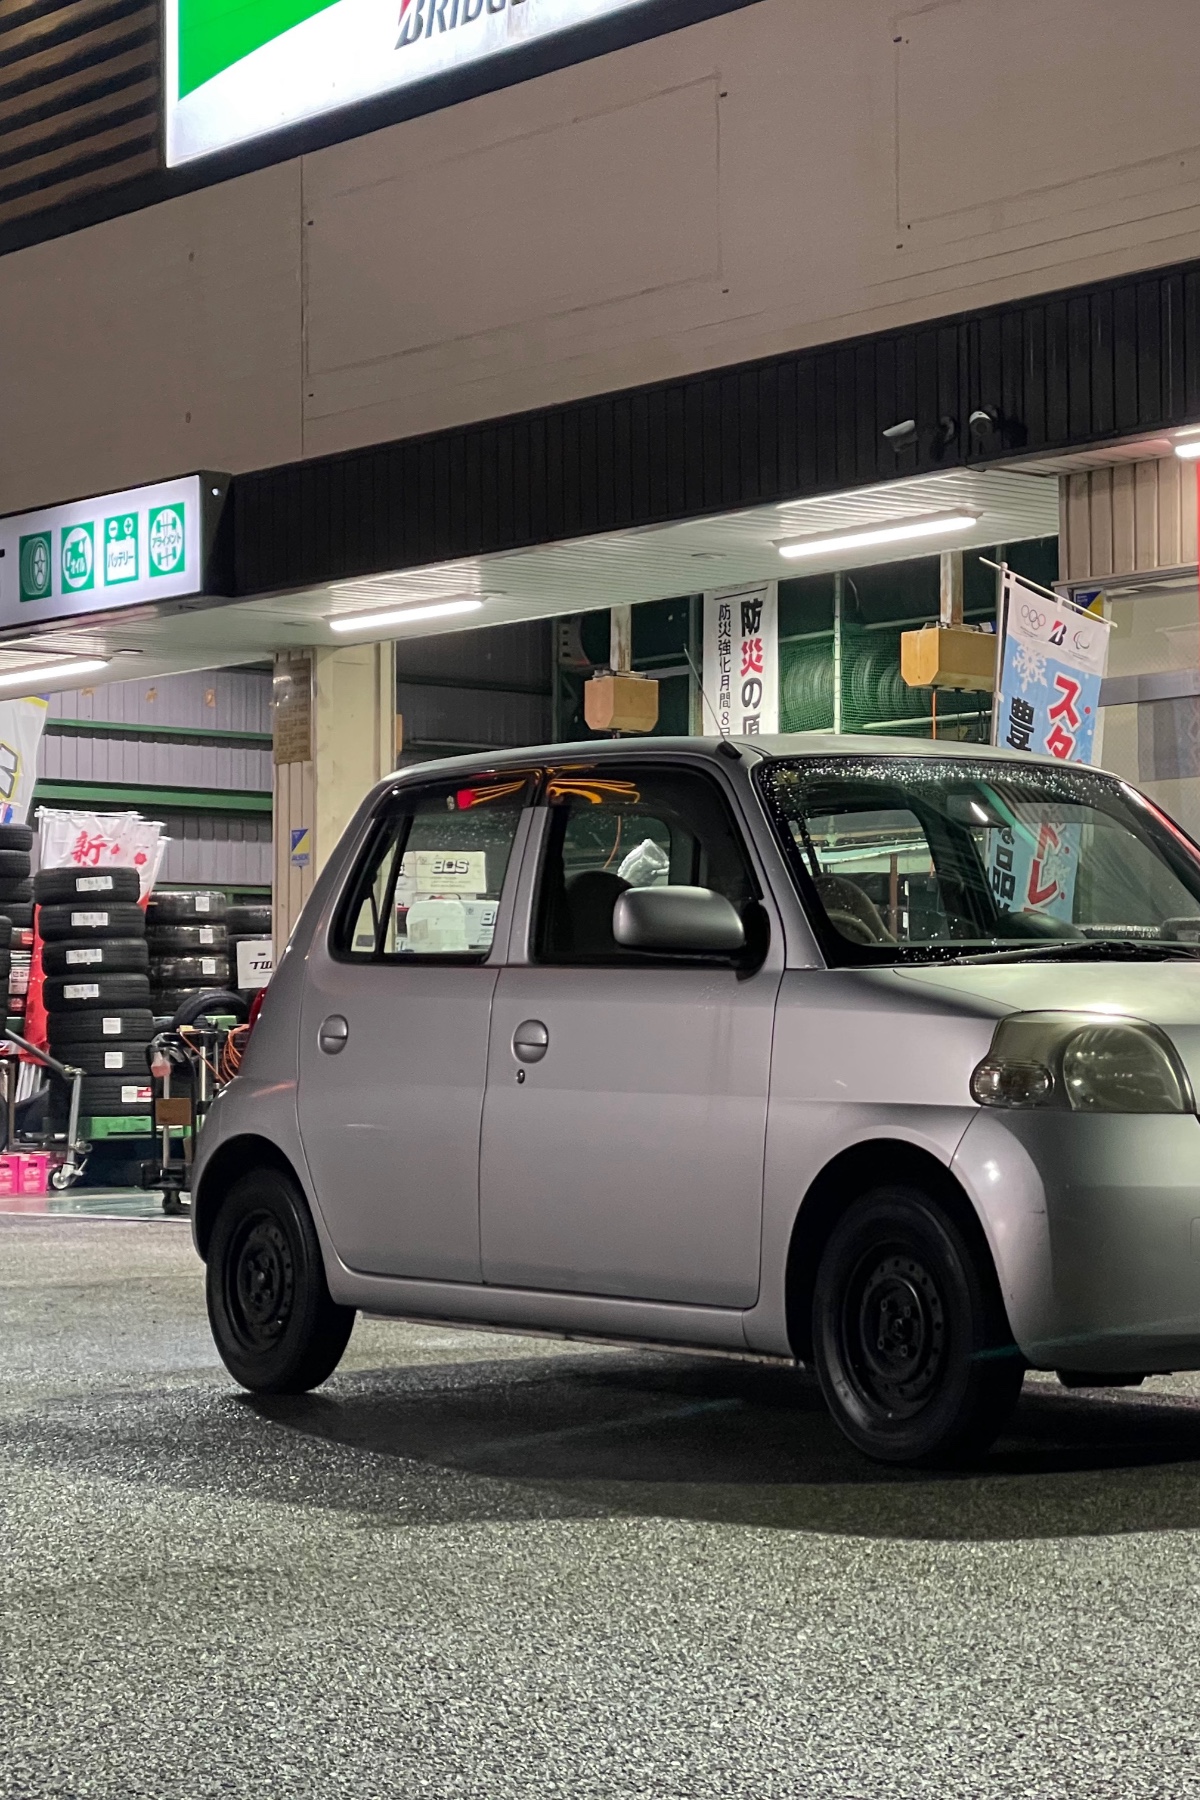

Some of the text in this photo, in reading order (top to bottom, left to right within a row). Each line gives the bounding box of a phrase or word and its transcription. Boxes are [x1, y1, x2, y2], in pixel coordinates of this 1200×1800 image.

[394, 0, 526, 50] BRID
[152, 532, 182, 548] アライメント
[70, 560, 86, 574] オイル
[107, 551, 134, 568] バッテリー
